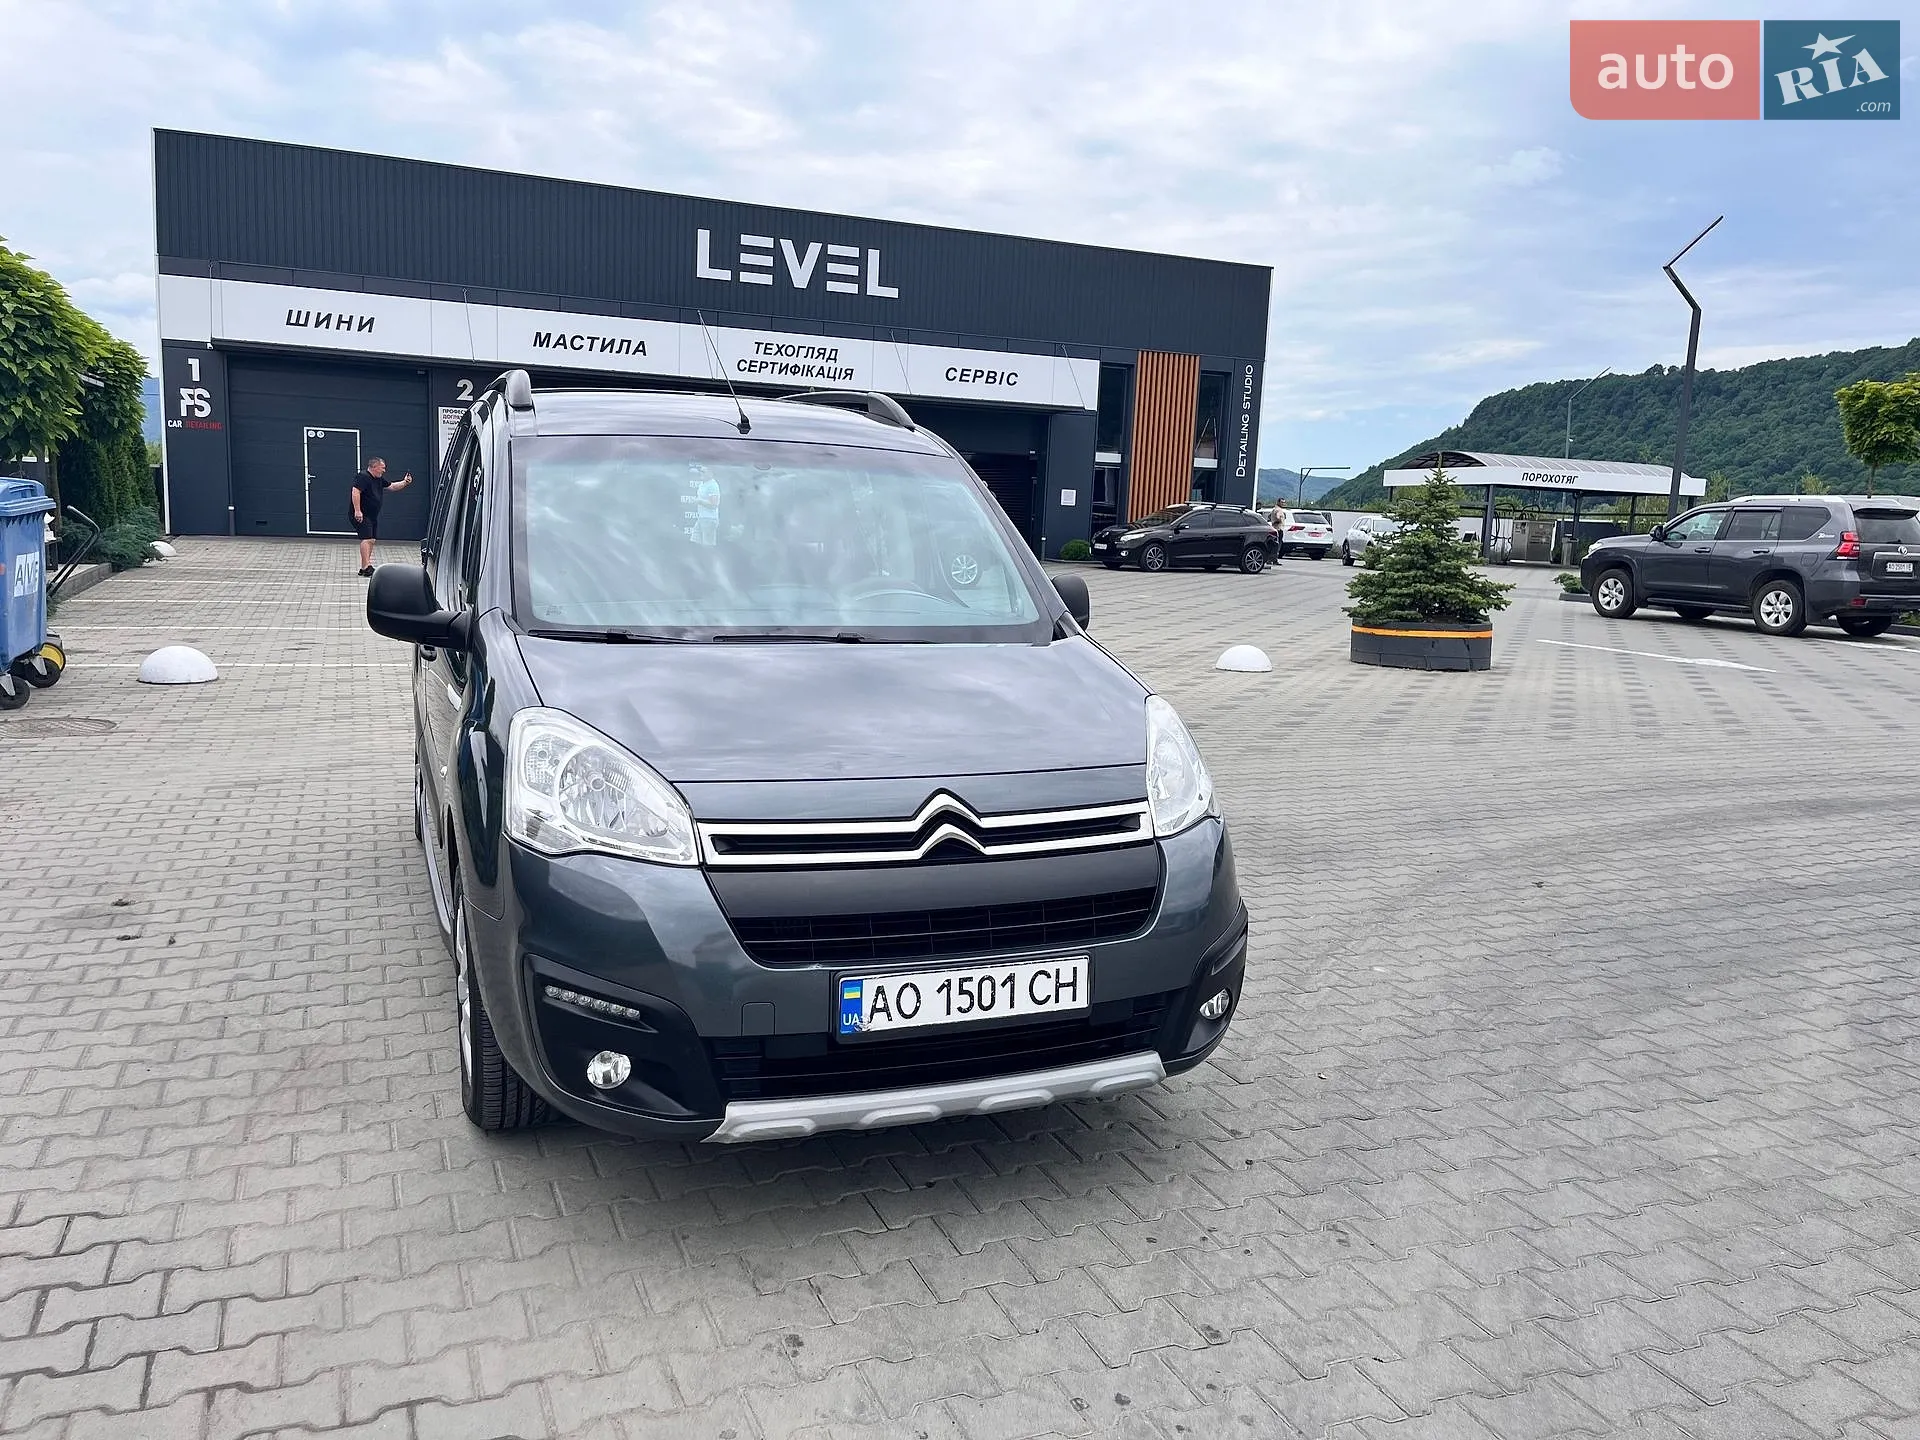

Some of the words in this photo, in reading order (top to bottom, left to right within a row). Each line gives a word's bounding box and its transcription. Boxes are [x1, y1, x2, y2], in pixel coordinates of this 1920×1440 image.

[696, 228, 899, 299] LEVEL
[285, 309, 376, 334] ШИНИ
[532, 331, 648, 357] МАСТИЛА
[754, 341, 839, 363] ТЕХОГЛЯД
[187, 357, 200, 382] 1
[736, 359, 855, 382] СЕРТИФІКАЦІЯ
[945, 366, 1019, 387] СЕРВІС
[456, 379, 474, 401] 2
[1242, 364, 1254, 410] STUDIO
[167, 420, 183, 428] CAR
[1235, 413, 1250, 478] DETAILING
[1521, 472, 1579, 485] ПОРОХОТЯГ
[868, 981, 922, 1022] AO
[936, 972, 1016, 1017] 1501
[1028, 966, 1078, 1006] CH
[843, 1014, 860, 1026] UA
